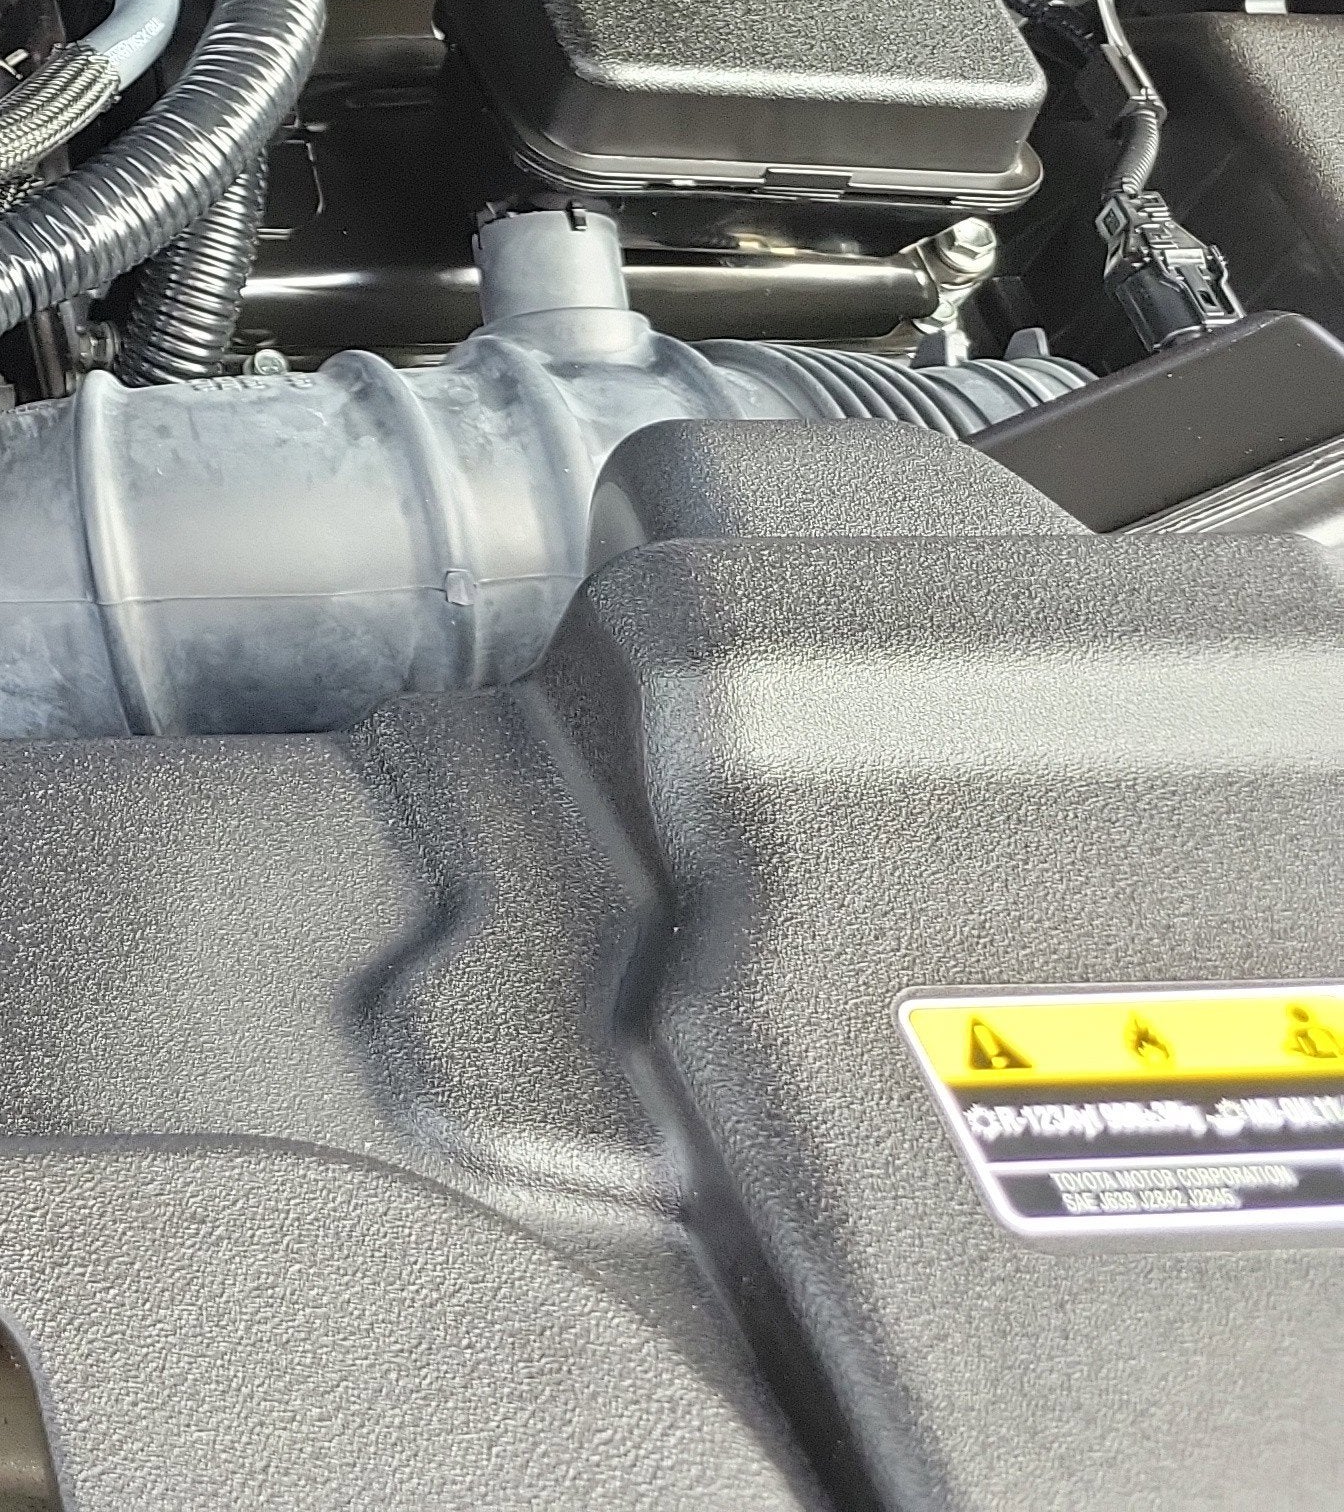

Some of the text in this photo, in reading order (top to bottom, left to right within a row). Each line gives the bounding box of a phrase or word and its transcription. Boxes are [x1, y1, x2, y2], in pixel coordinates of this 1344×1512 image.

[1050, 1165, 1299, 1191] TOYOTA MOTOR CORPORATION
[1062, 1188, 1240, 1214] SAE J639 J2842 J2845
